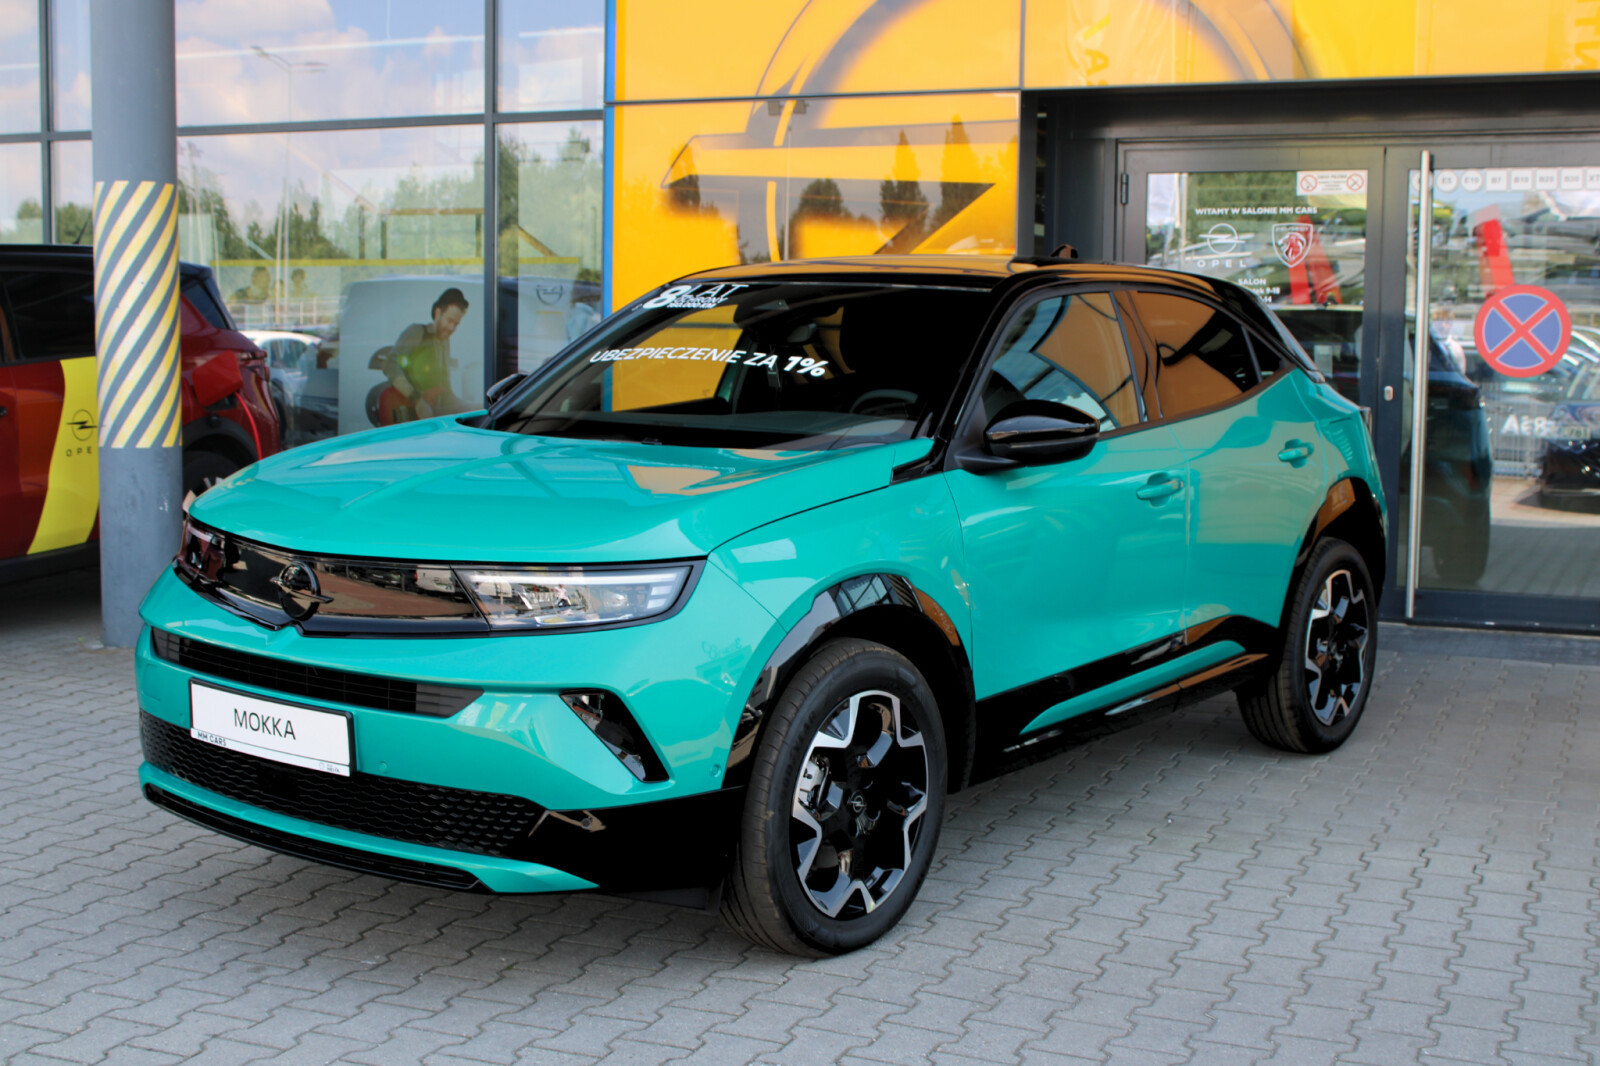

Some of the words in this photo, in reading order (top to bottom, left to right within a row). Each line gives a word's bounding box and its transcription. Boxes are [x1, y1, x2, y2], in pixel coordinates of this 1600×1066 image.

[1241, 207, 1278, 215] SALONIE
[1295, 206, 1318, 214] CARS
[1197, 259, 1247, 268] OPEL
[1238, 278, 1267, 286] SALON
[642, 284, 692, 309] 8
[682, 283, 750, 298] LAT
[589, 347, 747, 363] UBEZPIECZENIE
[743, 352, 777, 369] ZA
[783, 356, 829, 377] 1%
[65, 446, 93, 457] OPE
[233, 708, 297, 741] MOKKA
[197, 731, 209, 741] MM
[209, 734, 227, 747] CARS
